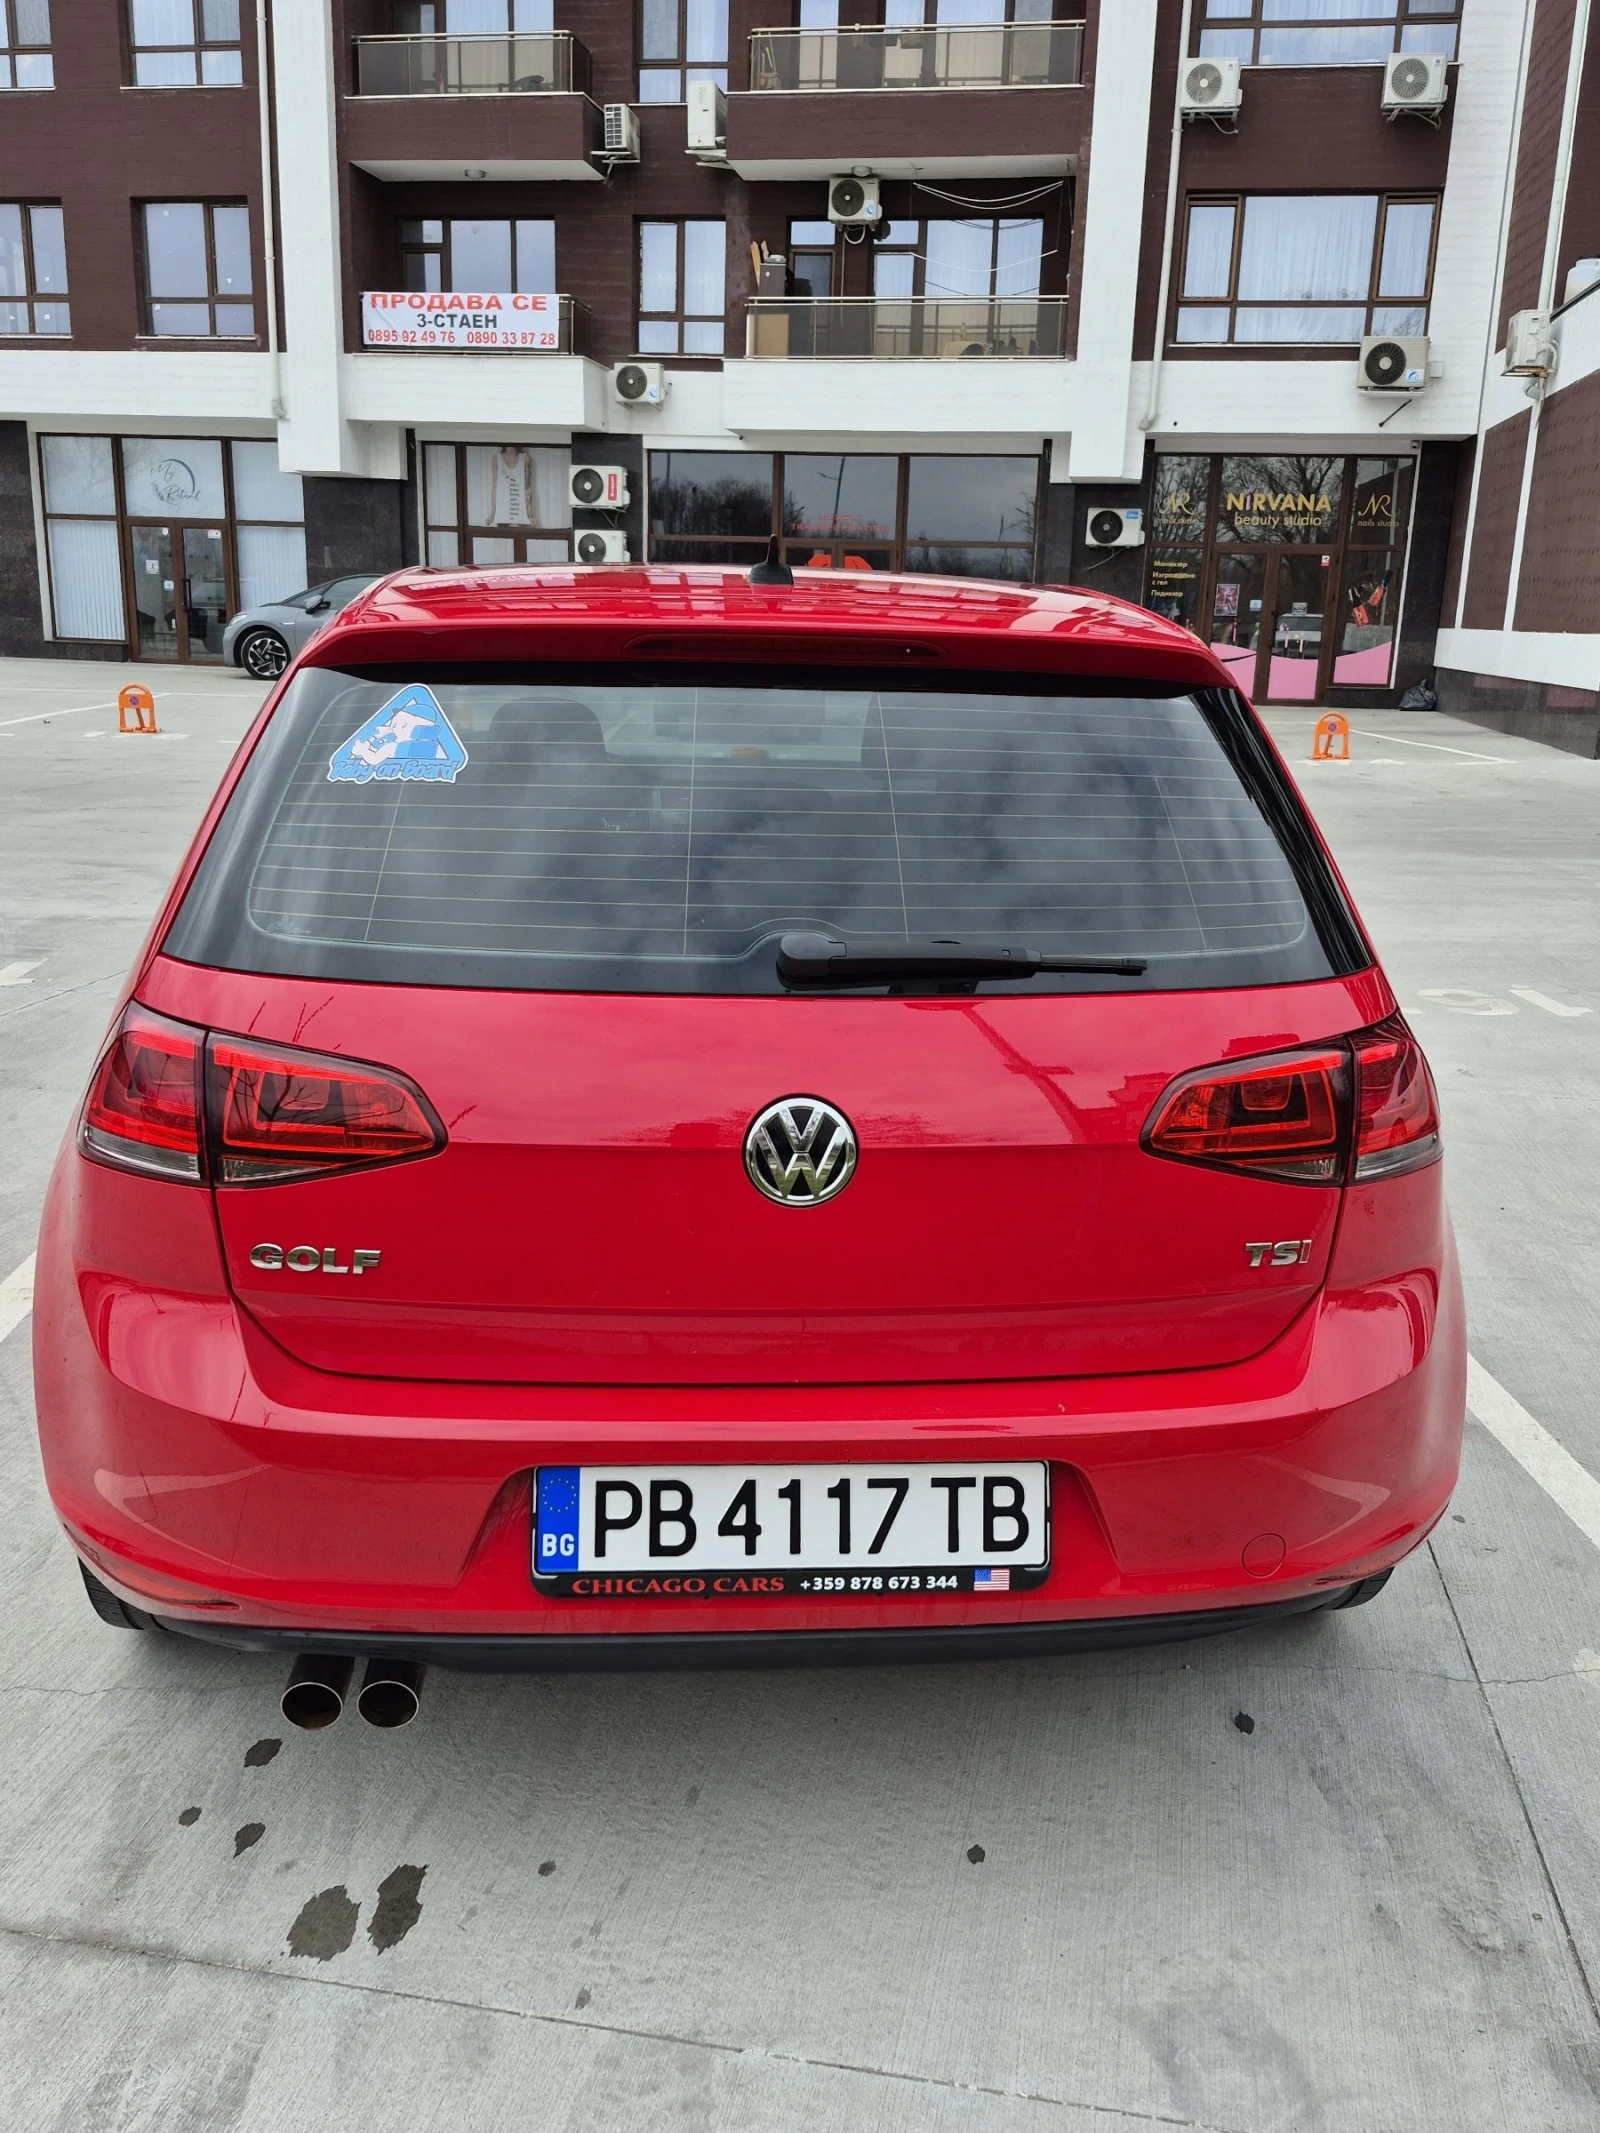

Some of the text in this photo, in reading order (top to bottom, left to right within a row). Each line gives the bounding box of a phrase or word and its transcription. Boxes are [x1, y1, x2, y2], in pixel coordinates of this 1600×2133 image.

[371, 294, 547, 312] ПРОДАВА СЕ
[417, 314, 497, 329] 3-СТАЕН
[368, 329, 455, 343] 0895 92 49 76
[467, 331, 555, 346] 0890 33 87 28
[150, 462, 175, 484] My
[1234, 512, 1322, 529] beauty studio
[1357, 519, 1375, 527] nails
[330, 761, 374, 781] Baby
[402, 760, 459, 780] Board
[250, 1243, 381, 1274] GOLF
[1245, 1240, 1312, 1267] TSI
[594, 1476, 1030, 1558] PB 4117 TB
[541, 1532, 575, 1557] BG
[572, 1577, 784, 1594] CHICAGO CARS
[800, 1575, 958, 1591] +359 878 673 344
